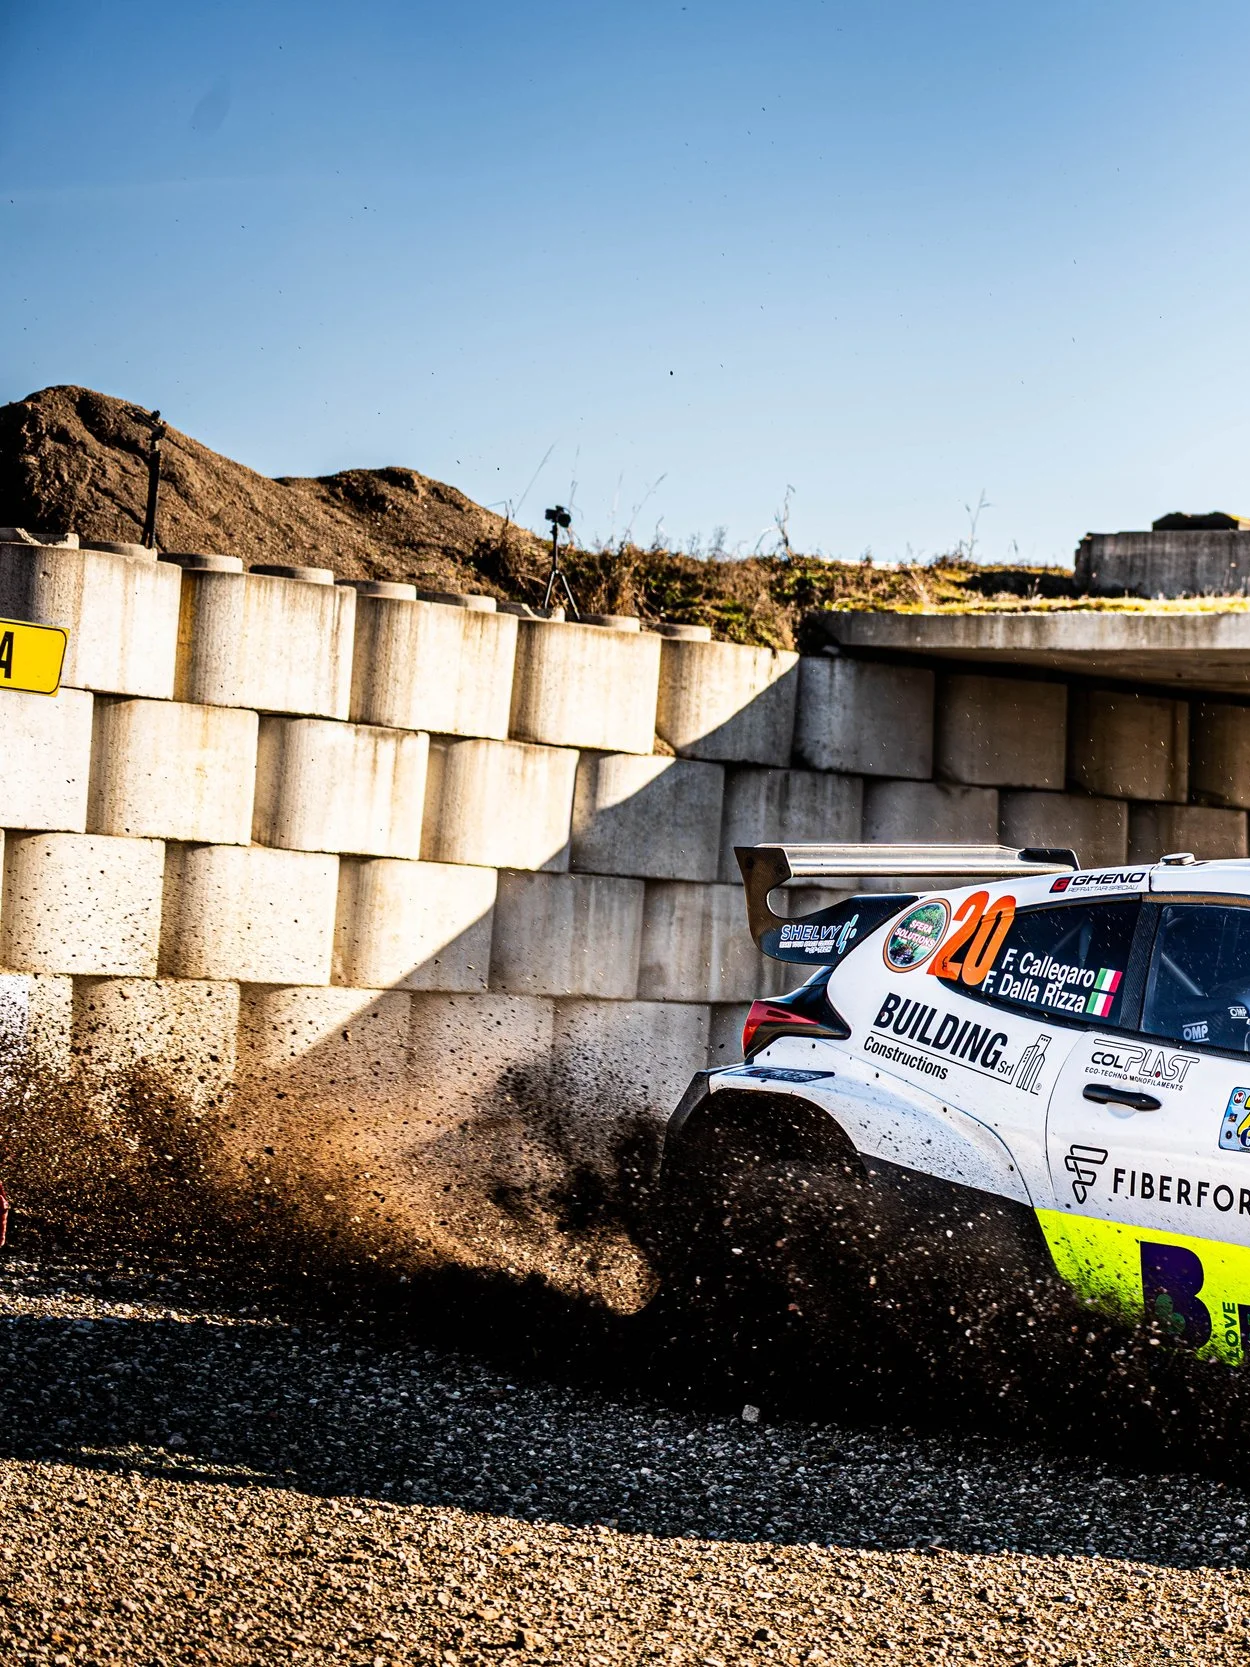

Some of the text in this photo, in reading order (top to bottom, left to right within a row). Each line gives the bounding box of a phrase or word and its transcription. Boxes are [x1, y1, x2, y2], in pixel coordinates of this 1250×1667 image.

[1072, 873, 1146, 885] GHENO
[781, 924, 842, 940] SHELVY
[895, 928, 936, 947] SOLUTIONS
[910, 920, 933, 934] SFERA
[926, 891, 1016, 986] 20
[1001, 948, 1095, 989] F. Callegaro
[981, 971, 1086, 1013] F. Dalla Rizza
[1230, 1008, 1247, 1017] OMP
[873, 992, 1014, 1076] BUILDING Srl
[1183, 1025, 1208, 1040] OMP
[863, 1036, 949, 1080] Constructions
[1085, 1067, 1183, 1091] ECO-TECHNO MONOFILAMENTS
[1140, 1241, 1212, 1351] B
